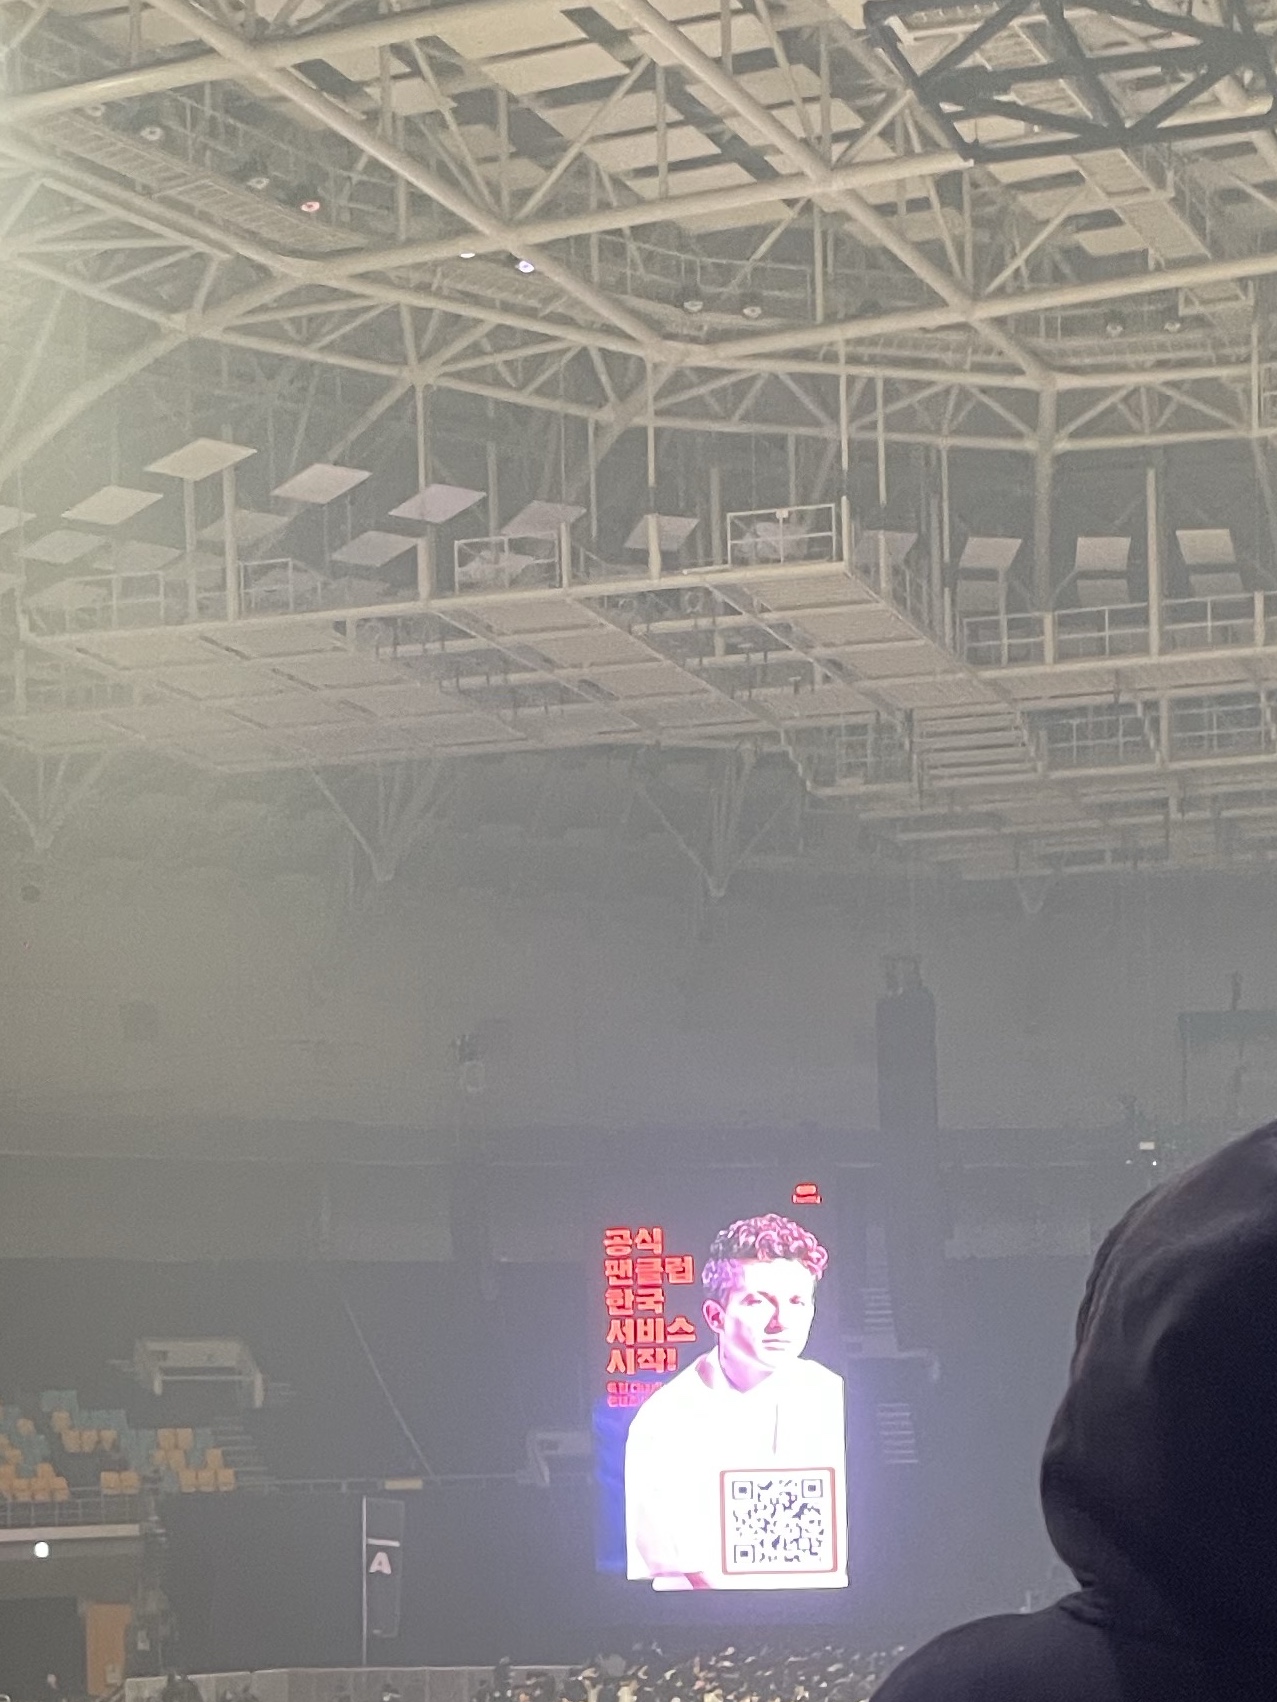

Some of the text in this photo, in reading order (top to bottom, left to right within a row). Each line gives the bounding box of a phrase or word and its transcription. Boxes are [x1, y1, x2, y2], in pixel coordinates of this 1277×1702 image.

[603, 1227, 662, 1256] 공식
[604, 1255, 694, 1286] 팬클럽
[604, 1287, 665, 1316] 한국
[606, 1317, 696, 1346] 서비스
[606, 1346, 677, 1375] 시작!
[369, 1551, 392, 1575] A
